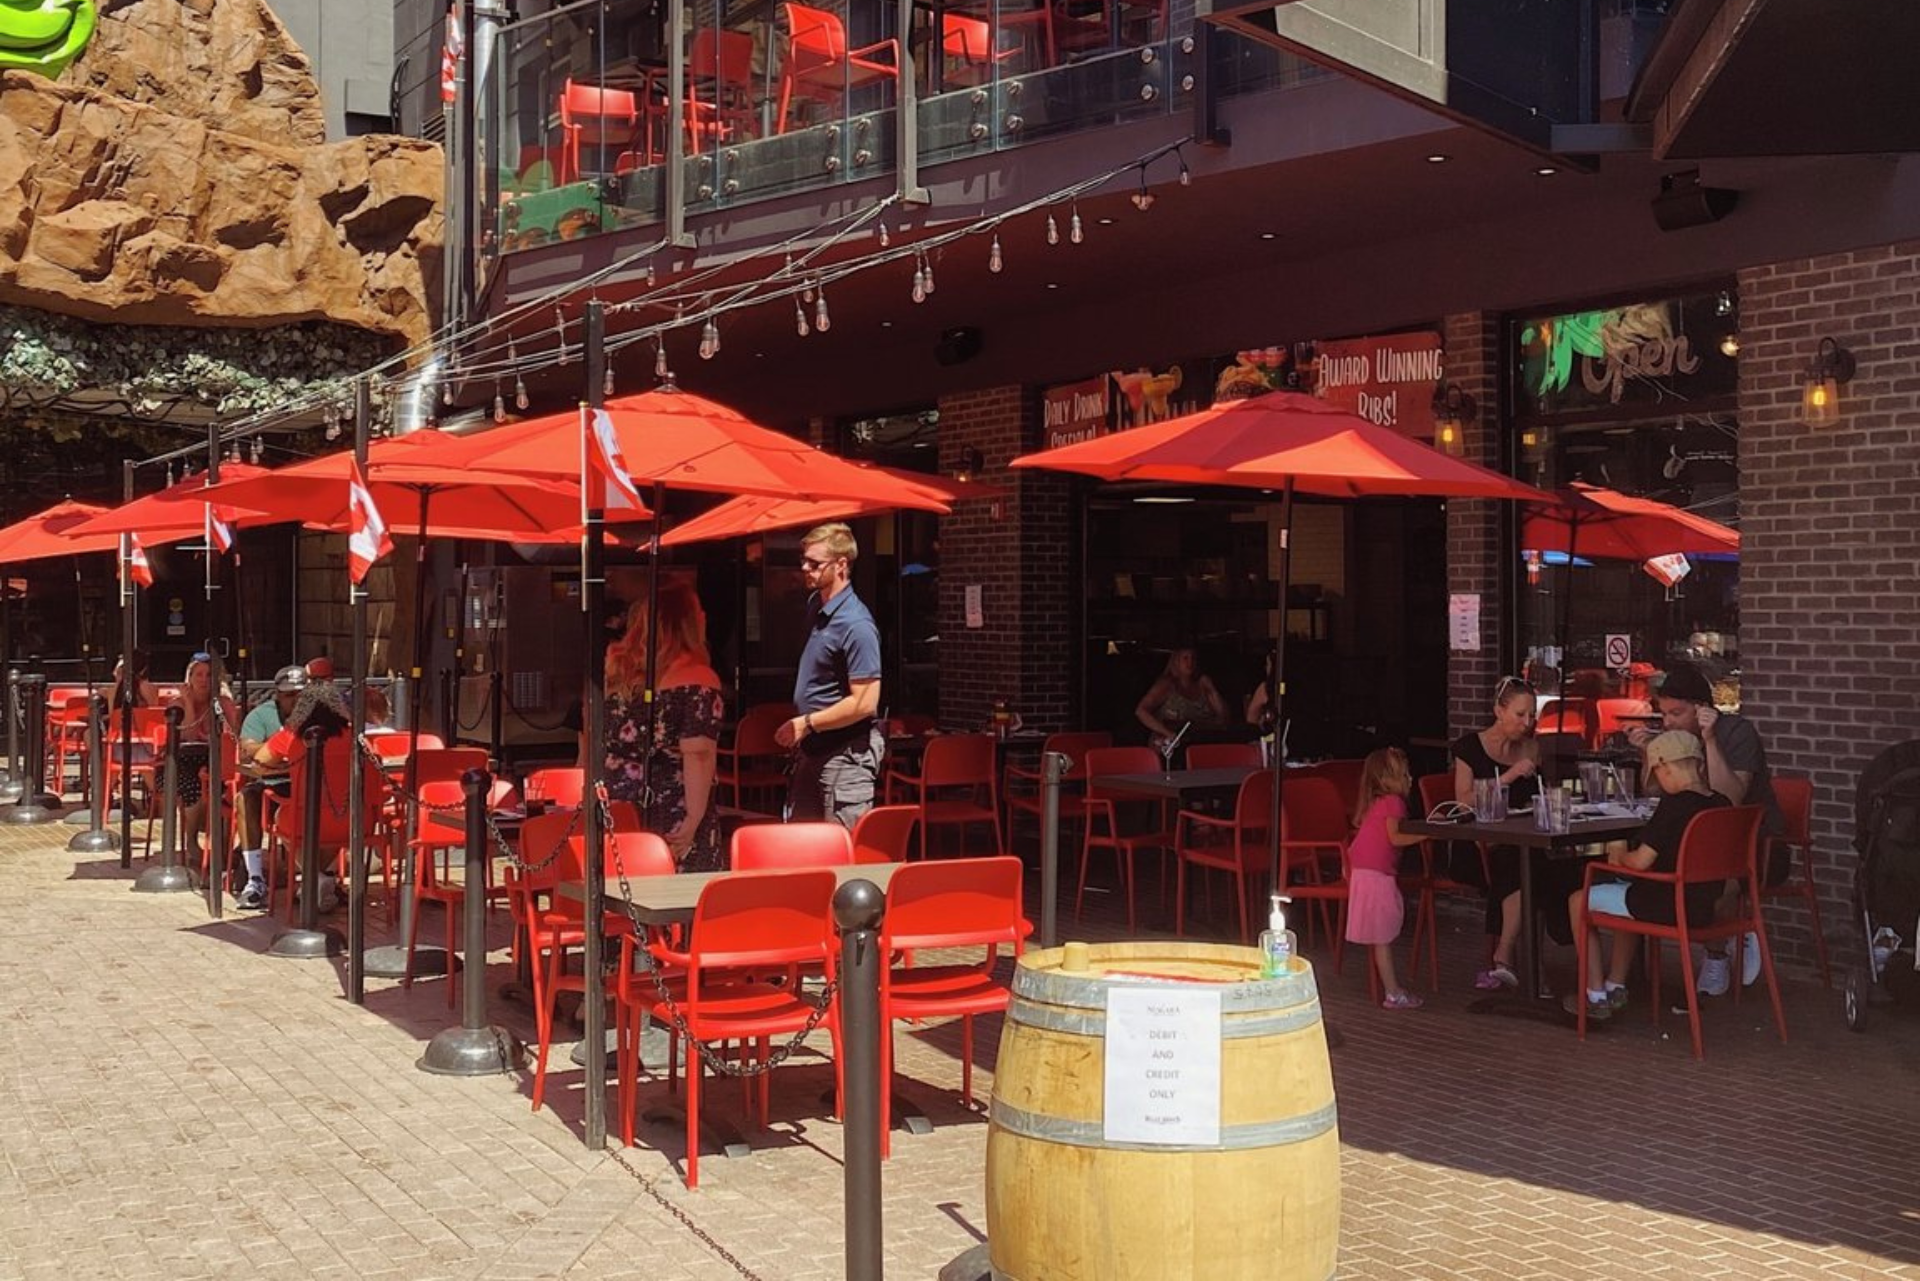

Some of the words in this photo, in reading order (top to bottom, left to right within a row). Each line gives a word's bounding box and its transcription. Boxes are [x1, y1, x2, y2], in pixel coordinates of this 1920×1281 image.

[1319, 353, 1369, 388] AWARD
[1376, 347, 1443, 383] WINNING
[1581, 323, 1700, 404] Open
[1043, 399, 1071, 429] DAILY
[1074, 391, 1104, 423] DRINK
[1358, 390, 1398, 427] RIBS!
[1149, 1028, 1177, 1040] DEBIT
[1151, 1049, 1174, 1060] AND
[1146, 1068, 1180, 1080] CREDIT
[1149, 1088, 1176, 1099] ONLY
